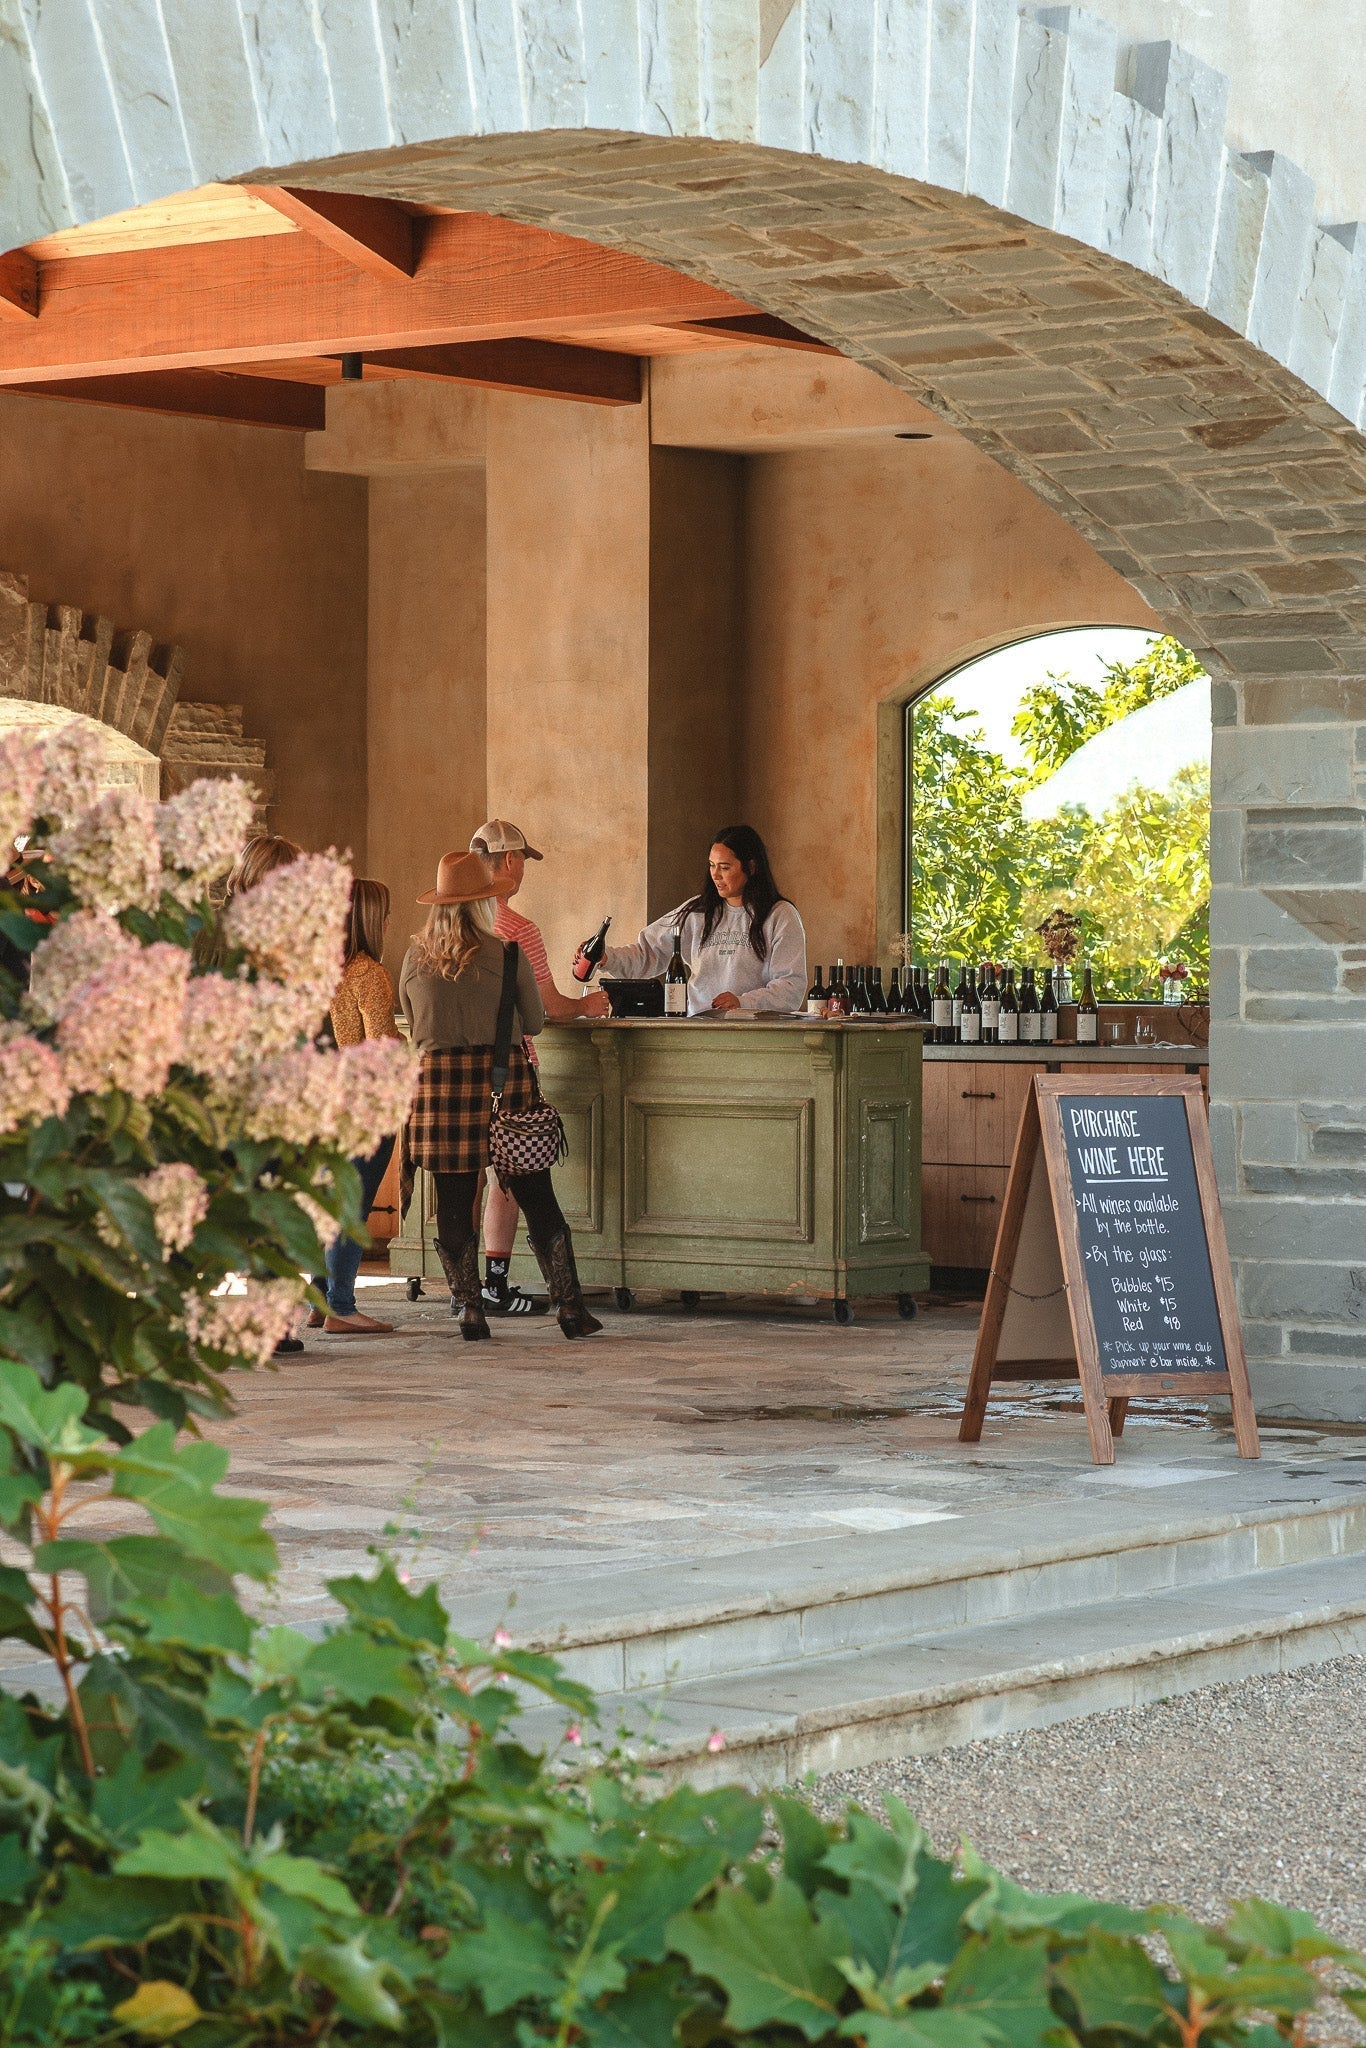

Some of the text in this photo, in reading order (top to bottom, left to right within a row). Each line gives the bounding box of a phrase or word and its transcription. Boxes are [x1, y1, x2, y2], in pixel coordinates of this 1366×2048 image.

[1070, 1108, 1141, 1138] PURCHASE
[1077, 1146, 1169, 1176] WINE HERE
[1099, 1195, 1131, 1215] wines
[1133, 1192, 1179, 1214] available
[1095, 1217, 1170, 1238] by the bottle.
[1112, 1245, 1134, 1263] the
[1139, 1246, 1173, 1269] glass:
[1111, 1274, 1175, 1294] Bubbles $15
[1116, 1296, 1177, 1314] White $15
[1122, 1315, 1181, 1332] Red $18
[1114, 1341, 1212, 1356] Pick up your wine club
[1159, 1355, 1173, 1367] bar
